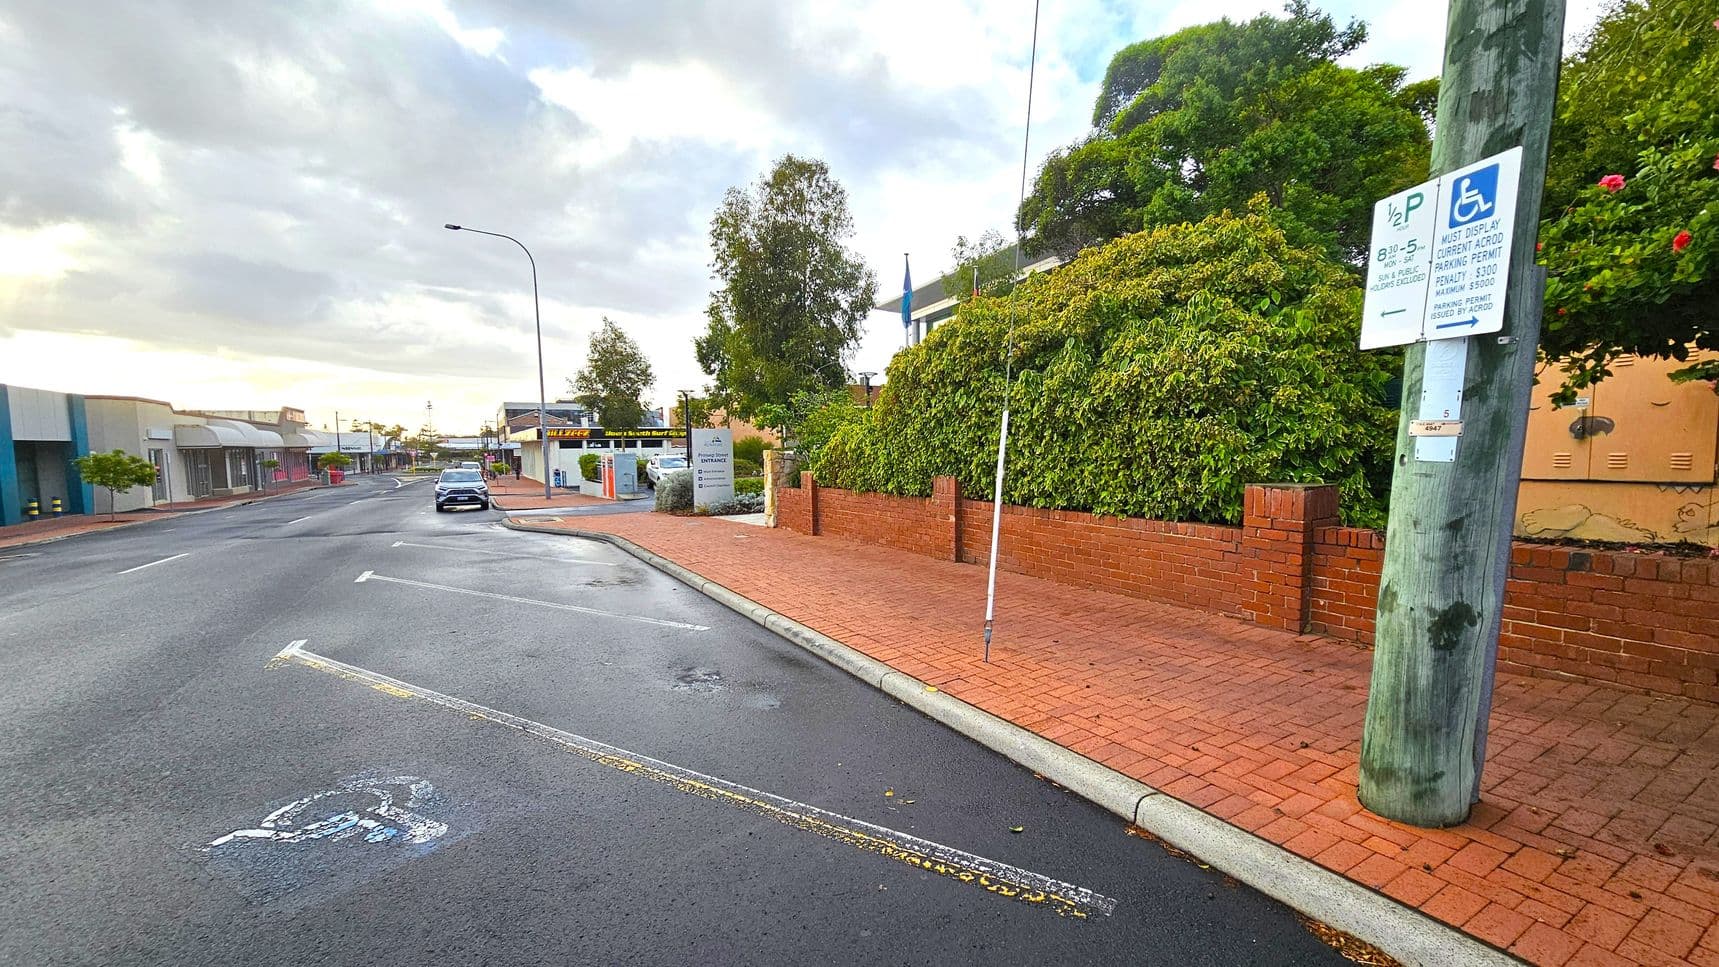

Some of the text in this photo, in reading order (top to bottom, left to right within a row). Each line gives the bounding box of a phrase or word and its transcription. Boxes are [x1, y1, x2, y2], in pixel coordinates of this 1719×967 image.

[1441, 219, 1501, 245] MUST DISPLAY
[1437, 232, 1504, 260] CURRENT ACROD
[1384, 259, 1397, 269] MON
[1403, 254, 1415, 264] SAT
[1434, 246, 1503, 273] PARKING PERMIT
[1370, 273, 1426, 292] HOLIDAYS EXCLUDED
[1378, 265, 1420, 282] SUN & PUBLIC
[1435, 271, 1467, 287] PENALTY
[1476, 263, 1498, 279] $300
[1434, 277, 1496, 297] MAXIMUM $5000
[1430, 302, 1494, 320] ISSUED BY ACROD
[1433, 293, 1492, 310] PARKING PERMIT
[1444, 410, 1450, 418] 5
